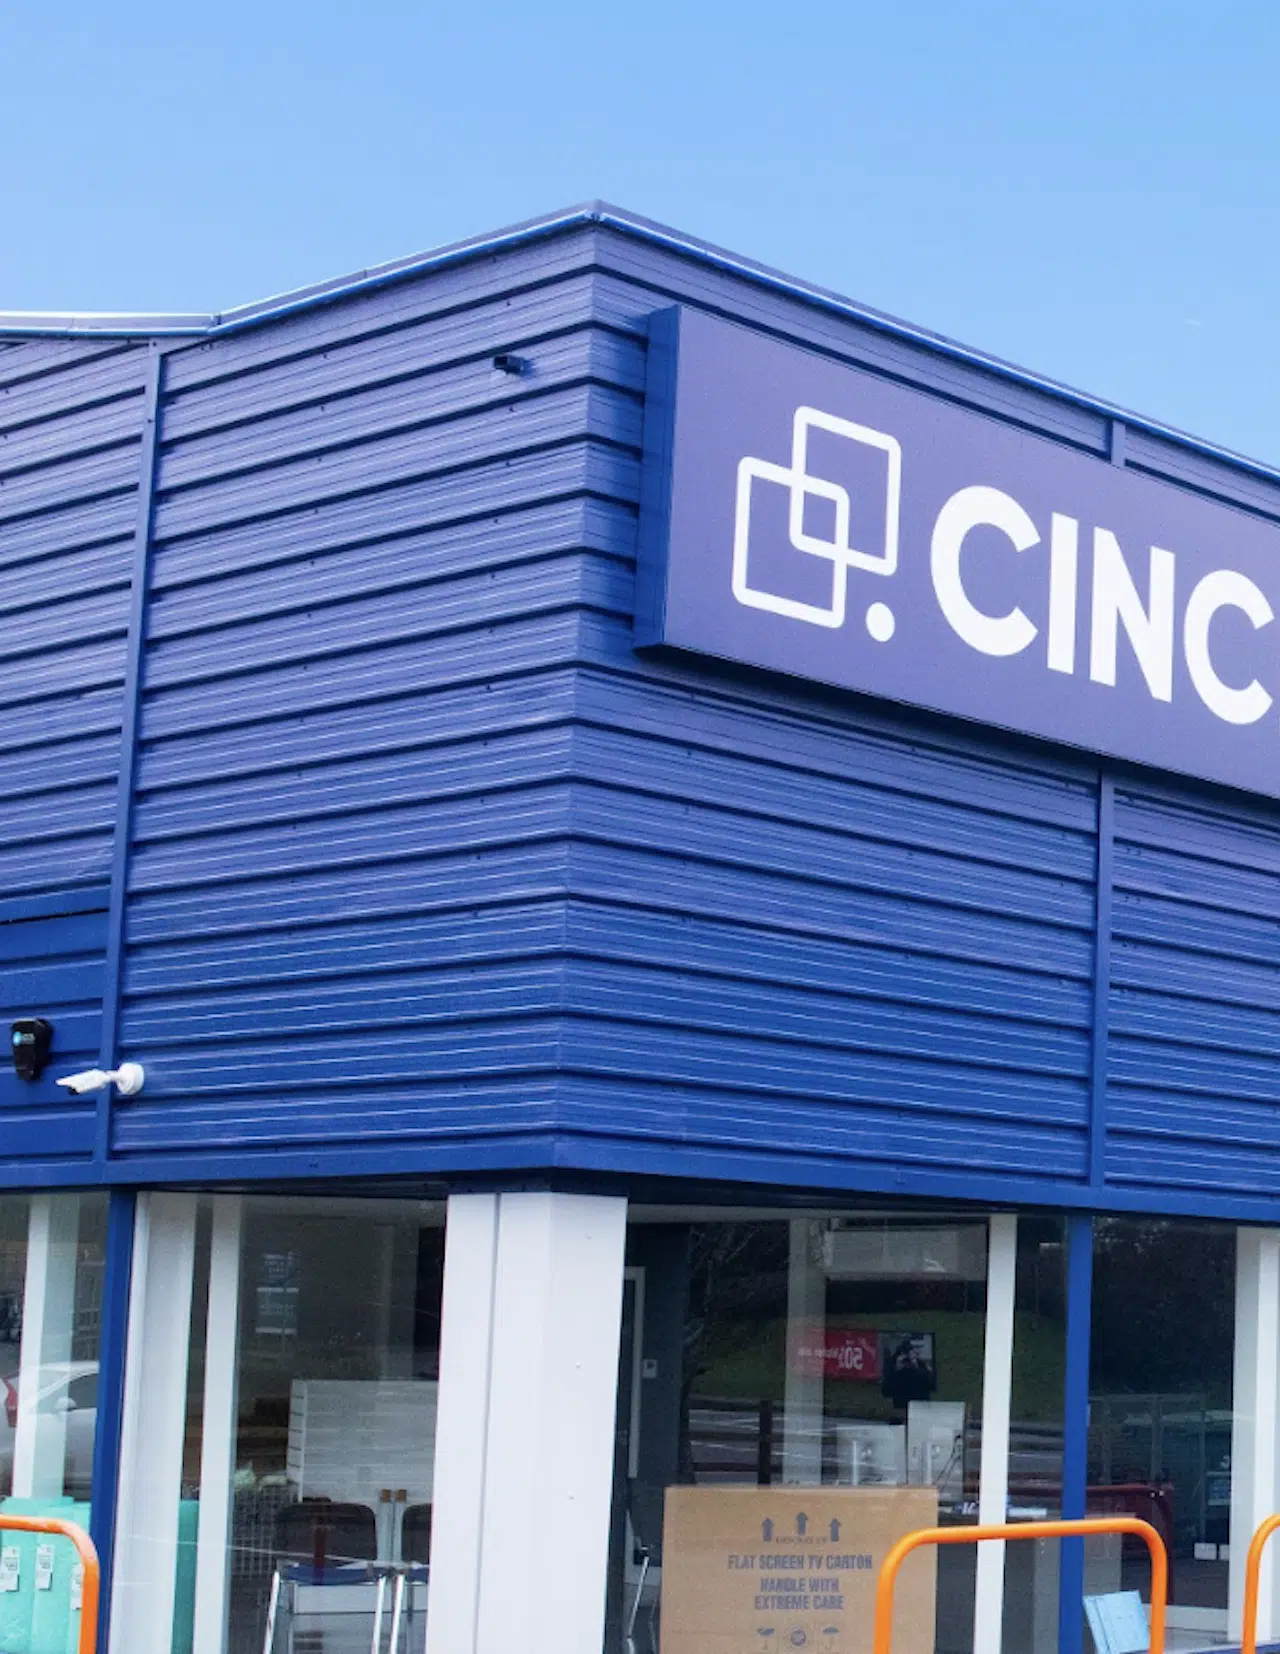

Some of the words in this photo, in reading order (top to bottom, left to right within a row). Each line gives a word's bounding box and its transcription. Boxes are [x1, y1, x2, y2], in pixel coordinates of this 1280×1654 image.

[728, 1554, 755, 1570] FLAT
[759, 1554, 804, 1570] SCREEN
[808, 1554, 824, 1570] TV
[826, 1554, 872, 1570] CARTON
[760, 1577, 805, 1593] HANDLE
[809, 1577, 839, 1593] WITH
[754, 1595, 809, 1610] EXTREME
[813, 1595, 844, 1610] CARE
